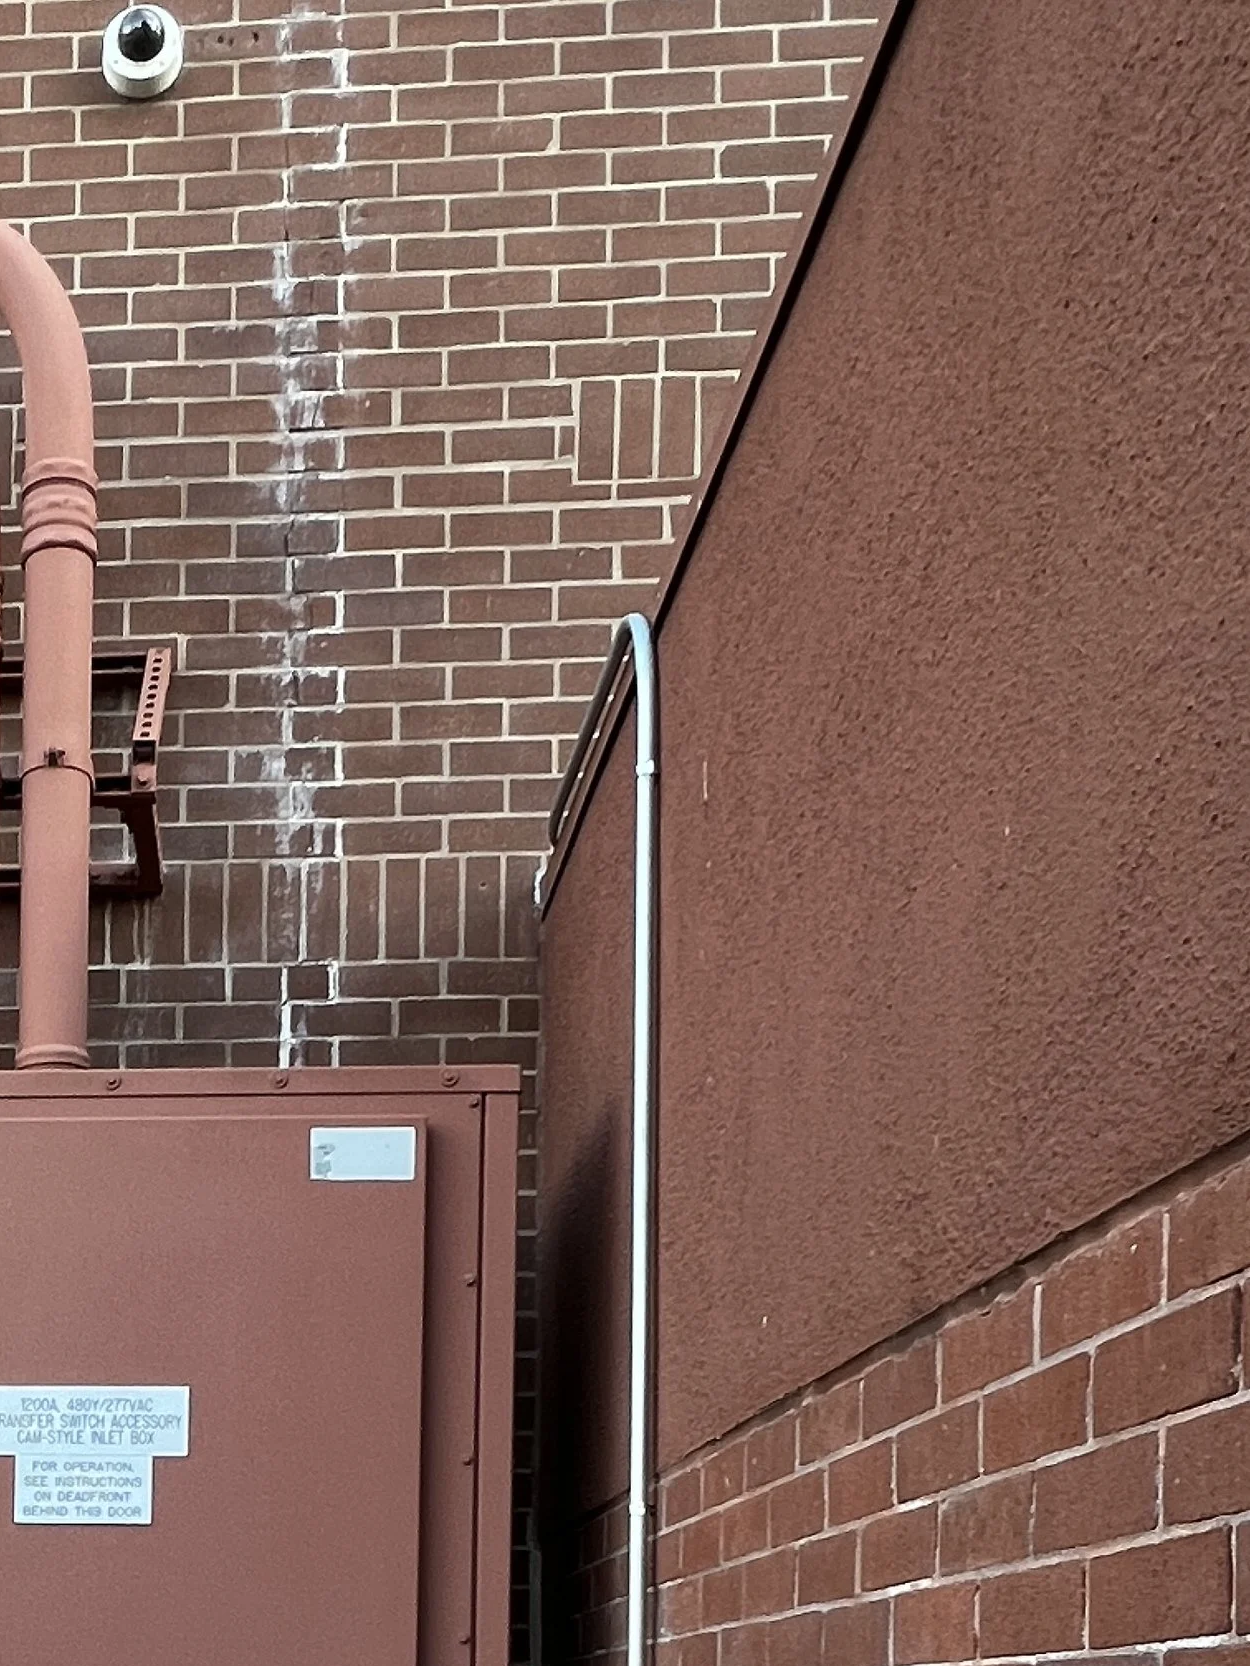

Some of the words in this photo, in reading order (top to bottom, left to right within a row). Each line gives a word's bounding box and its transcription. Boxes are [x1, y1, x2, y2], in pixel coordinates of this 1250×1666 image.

[66, 1397, 154, 1412] 480Y/277VAC
[59, 1413, 105, 1429] SWITCH
[110, 1413, 182, 1429] ACCESSORY
[16, 1429, 86, 1445] CAM-STYLE
[91, 1430, 124, 1445] INLET
[130, 1430, 155, 1445] BOX
[32, 1460, 57, 1472] FOR
[23, 1475, 49, 1487] SEE
[55, 1476, 143, 1488] INSTRUCTIONS
[34, 1490, 51, 1502] ON
[57, 1491, 132, 1502] DEADFRONT
[23, 1505, 68, 1517] BEHIND
[75, 1506, 101, 1517] THIS
[108, 1506, 142, 1517] DOOR
